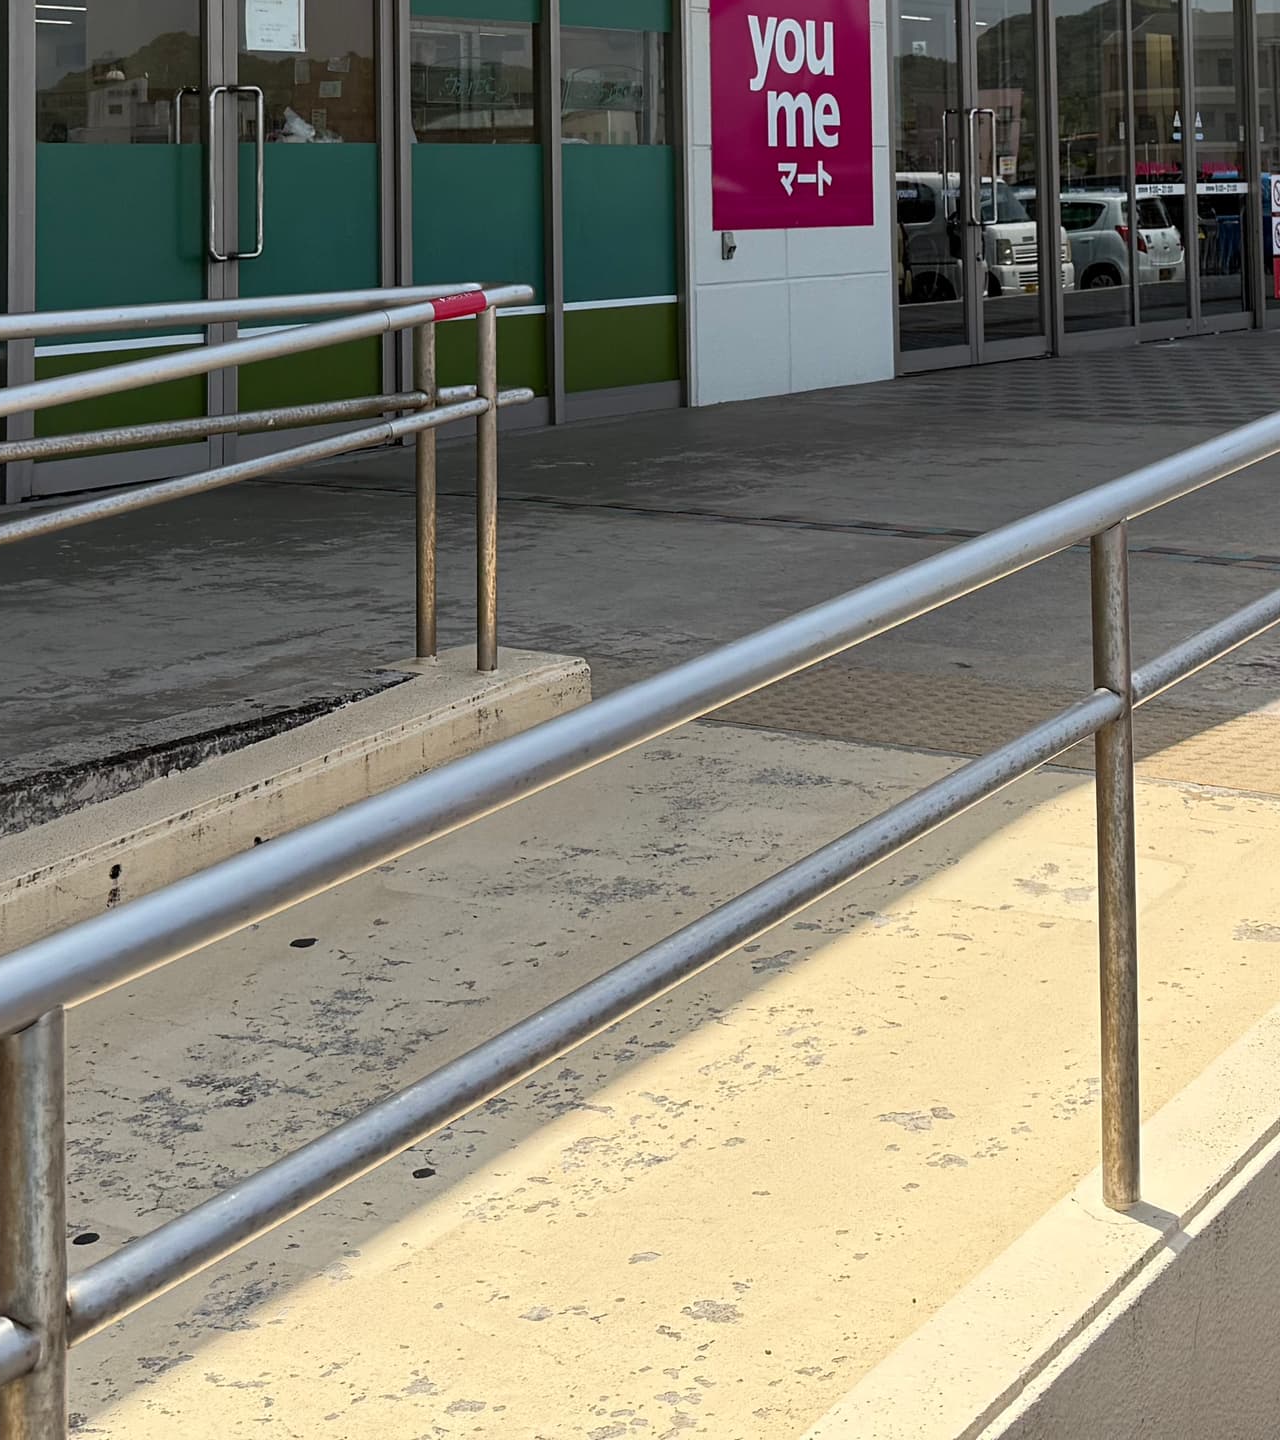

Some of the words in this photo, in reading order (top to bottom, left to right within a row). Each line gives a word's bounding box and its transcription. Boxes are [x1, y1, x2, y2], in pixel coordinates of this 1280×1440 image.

[747, 15, 835, 91] you
[767, 90, 841, 148] me
[777, 160, 832, 197] マート
